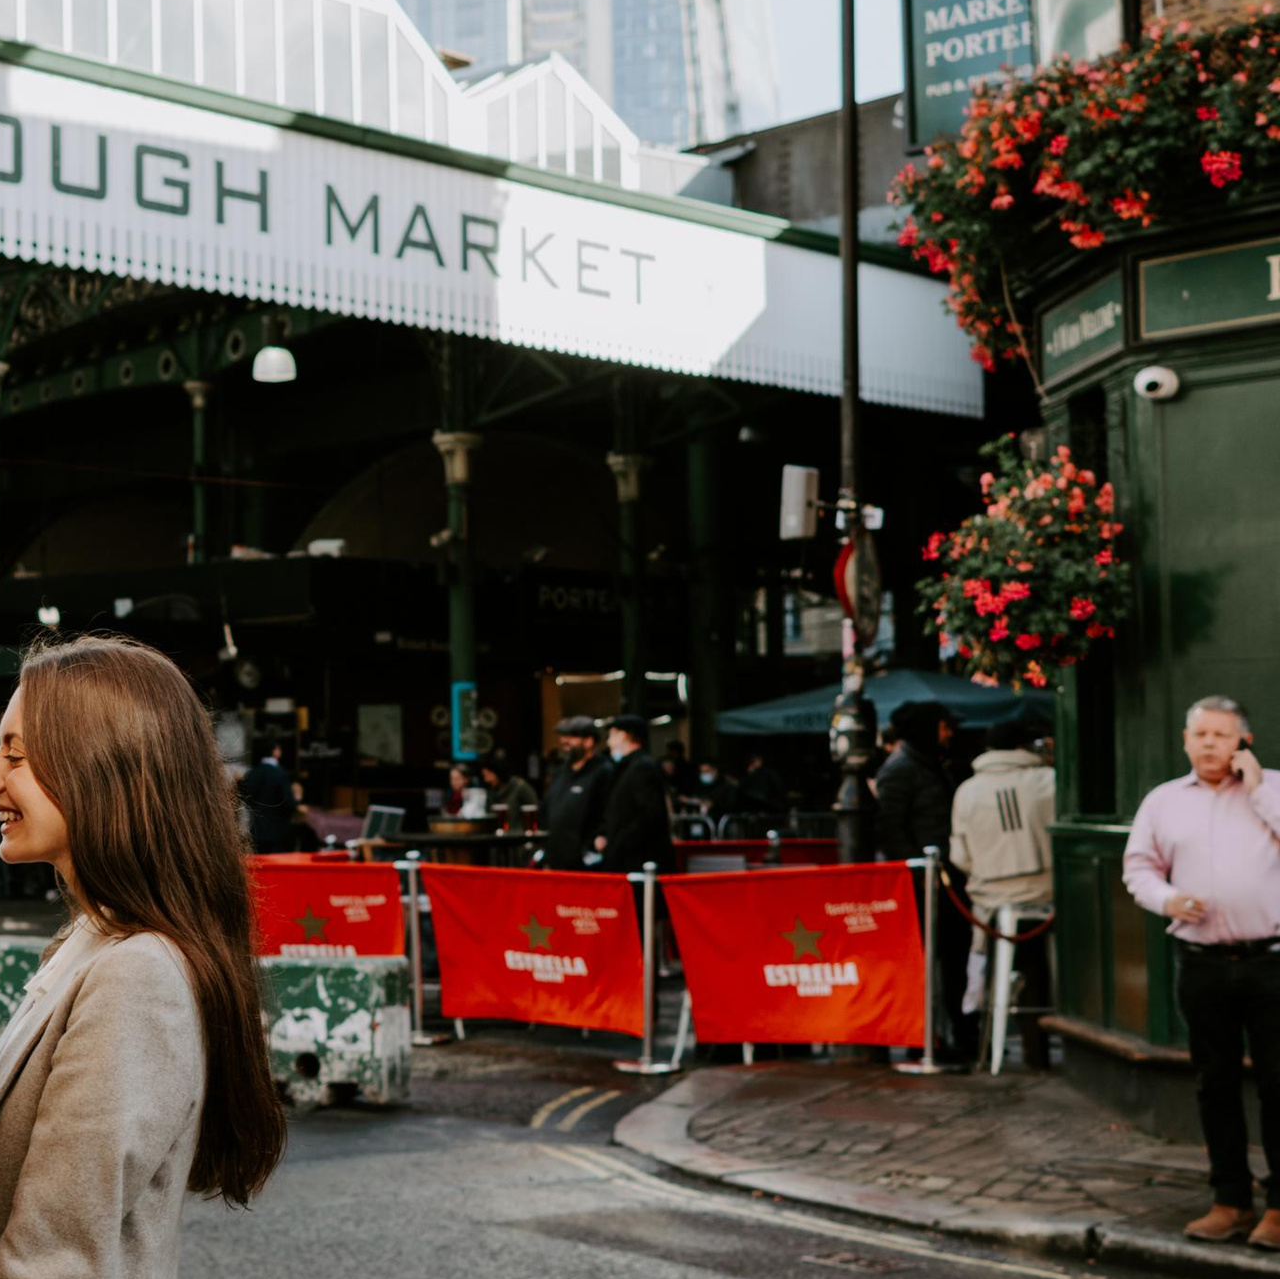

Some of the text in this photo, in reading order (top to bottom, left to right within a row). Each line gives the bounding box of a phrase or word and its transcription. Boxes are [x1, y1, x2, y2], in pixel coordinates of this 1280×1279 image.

[324, 183, 656, 305] MARKET
[504, 949, 588, 977] ESTRELLA
[763, 961, 859, 987] ESTRELLA
